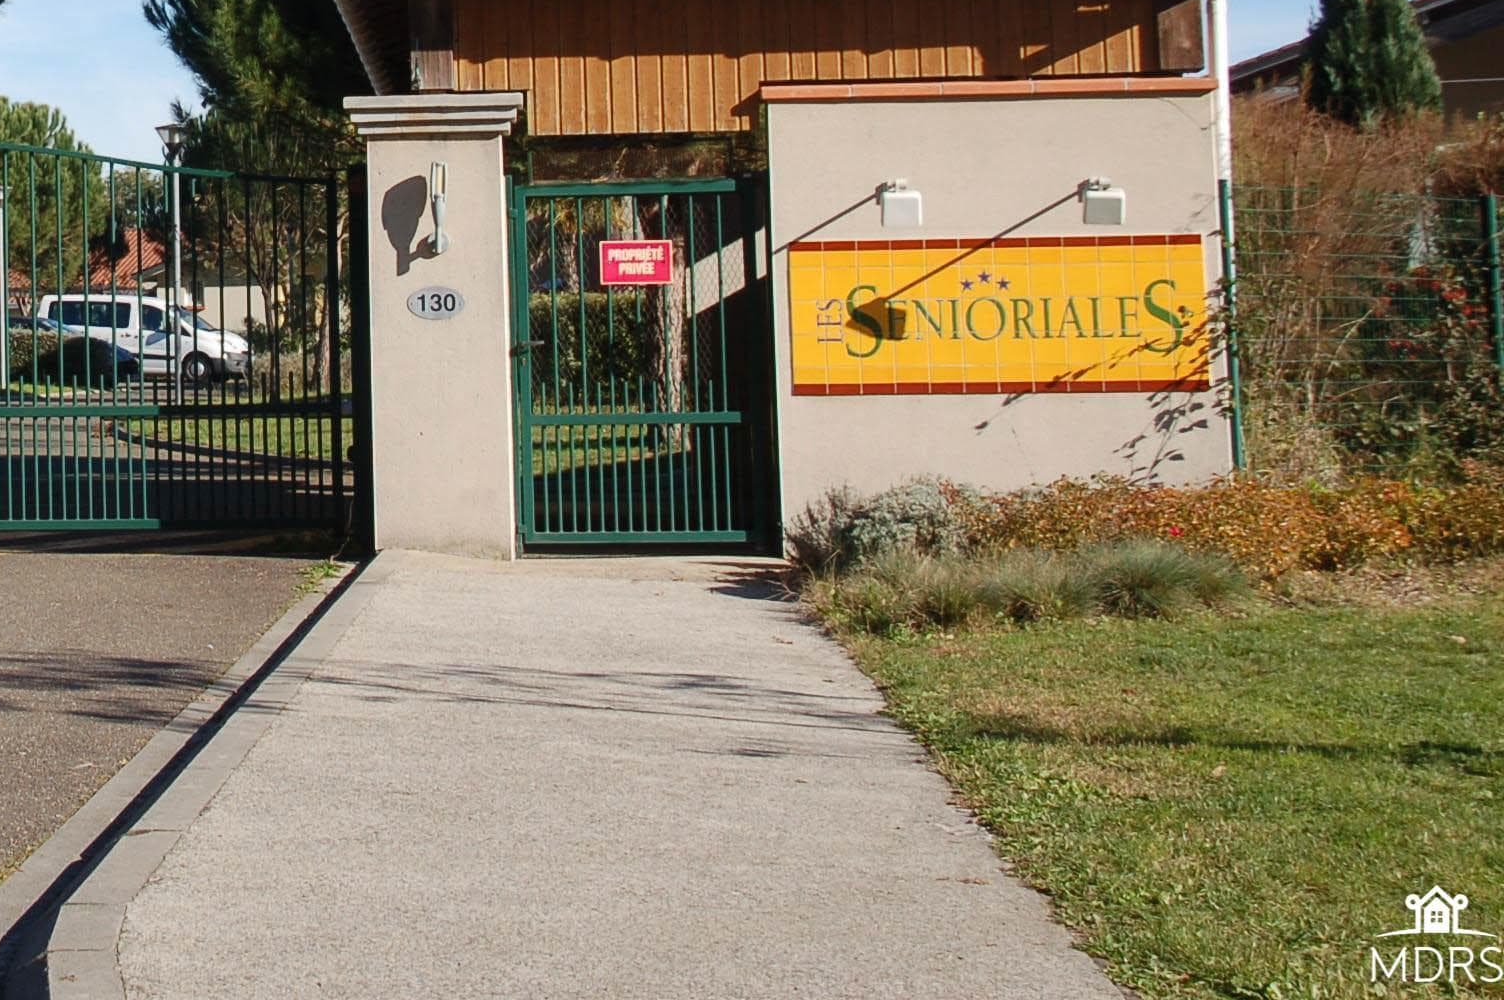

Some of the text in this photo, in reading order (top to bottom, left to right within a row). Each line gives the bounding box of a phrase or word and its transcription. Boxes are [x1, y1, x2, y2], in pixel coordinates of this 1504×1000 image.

[608, 245, 664, 261] PROPRIÉTÉ
[618, 261, 655, 275] PRIVÉE
[417, 293, 456, 312] 130
[817, 299, 843, 343] LES
[846, 279, 1183, 358] SENIORIALES
